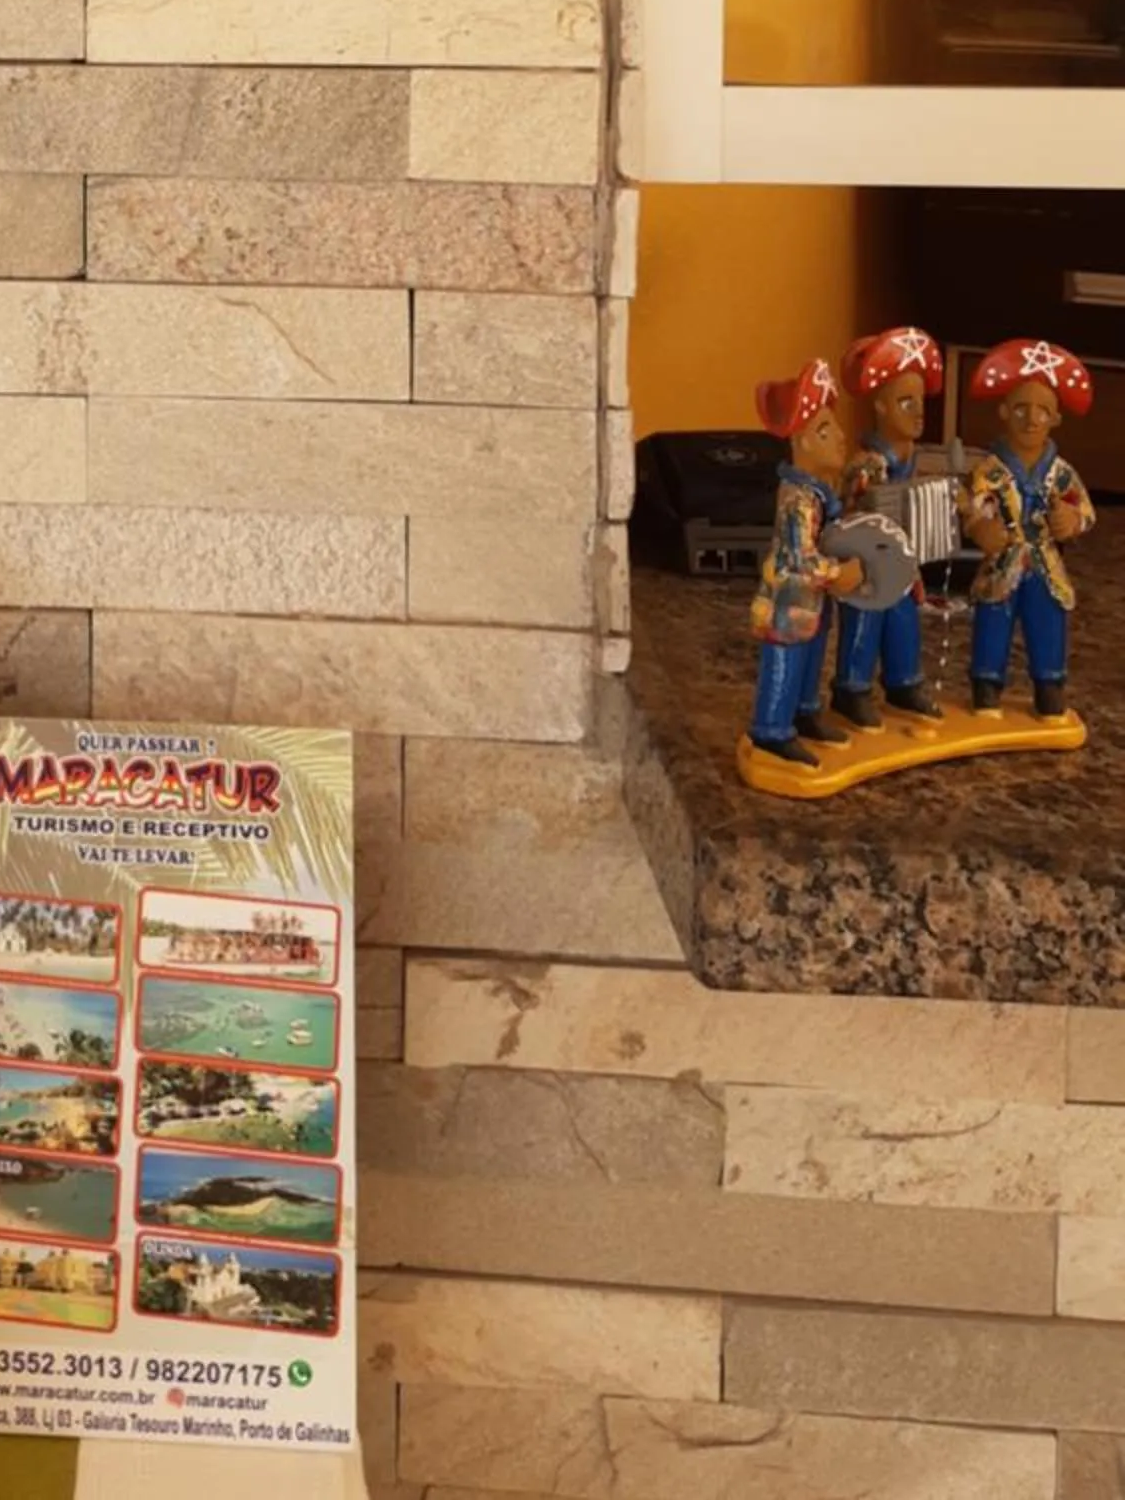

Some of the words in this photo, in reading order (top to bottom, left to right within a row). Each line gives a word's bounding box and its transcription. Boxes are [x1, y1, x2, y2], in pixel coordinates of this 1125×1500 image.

[78, 732, 124, 753] QUER
[128, 735, 201, 755] PASSEAR
[14, 815, 115, 836] TURISMO
[122, 819, 137, 836] E
[143, 819, 270, 841] RECEPTIVO
[78, 843, 106, 863] VAI
[108, 845, 133, 864] TE
[129, 1355, 139, 1379] /
[146, 1357, 284, 1389] 982207175
[185, 1393, 268, 1412] maracatur
[130, 1413, 180, 1436] Tesouro
[239, 1419, 274, 1441] Porto
[276, 1422, 292, 1442] de
[295, 1422, 351, 1444] Galinhas
